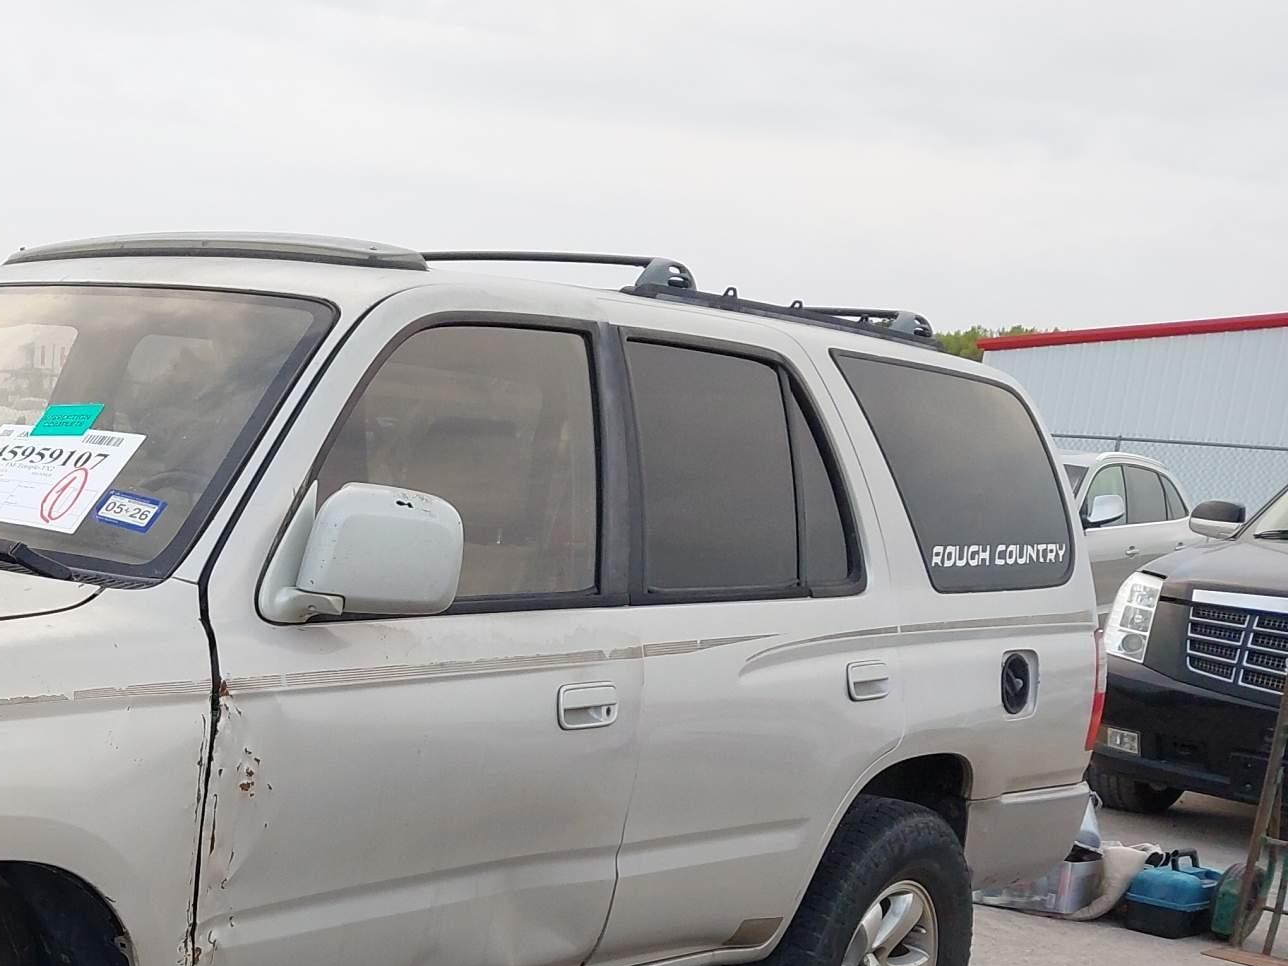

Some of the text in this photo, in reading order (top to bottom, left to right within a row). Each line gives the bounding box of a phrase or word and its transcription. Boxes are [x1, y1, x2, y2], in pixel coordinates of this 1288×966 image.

[105, 501, 126, 514] 05
[128, 507, 151, 521] 26
[931, 543, 1065, 567] ROUGH COUNTRY
